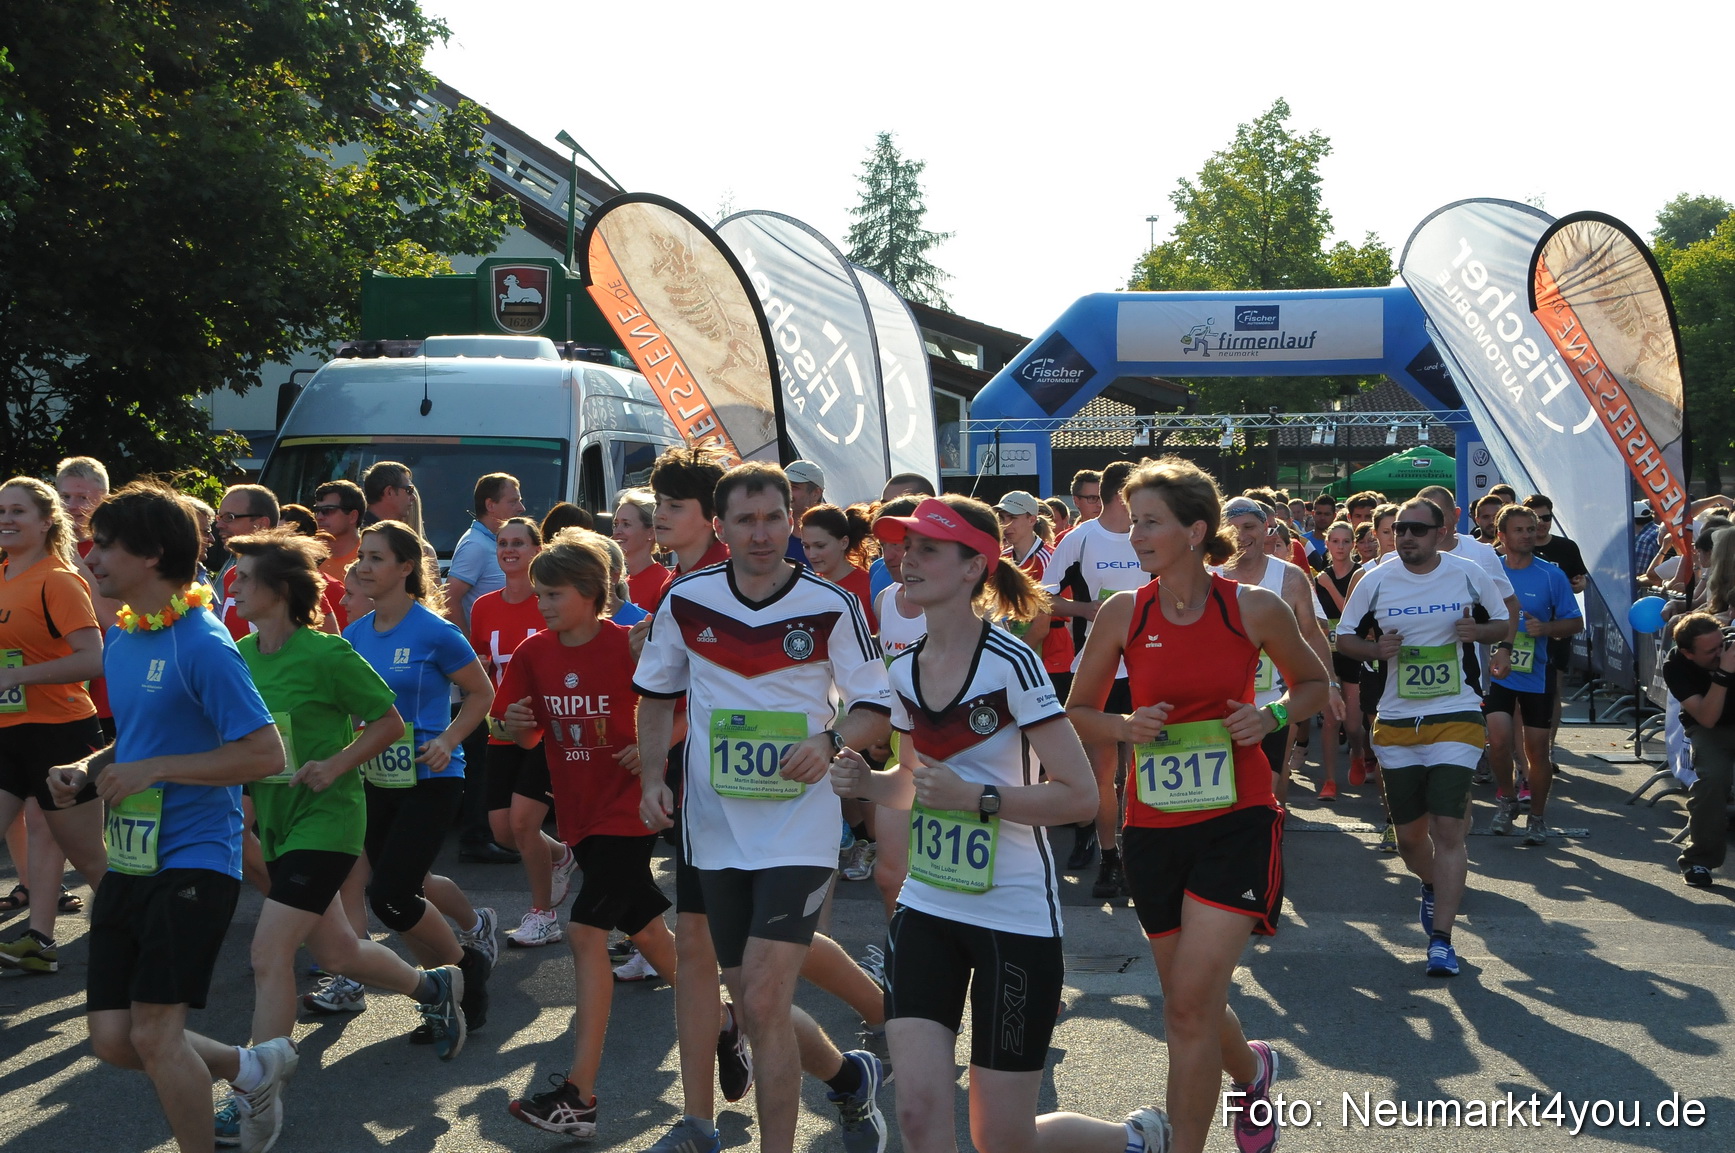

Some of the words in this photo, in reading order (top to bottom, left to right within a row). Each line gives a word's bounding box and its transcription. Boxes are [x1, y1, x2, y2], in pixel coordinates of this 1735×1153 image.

[508, 317, 534, 328] 1628
[1244, 314, 1277, 322] Fischer
[1218, 331, 1317, 350] firmenlauf
[1032, 366, 1084, 378] Fischer
[926, 512, 957, 529] 2XU
[1388, 602, 1461, 617] DELPHI
[1405, 663, 1451, 686] 203
[543, 695, 611, 716] TRIPLE
[565, 750, 590, 761] 2013
[1140, 751, 1227, 791] 1317
[109, 813, 157, 854] 1177
[912, 815, 991, 870] 1316
[941, 865, 958, 874] Luber
[1002, 962, 1027, 1055] 2XU
